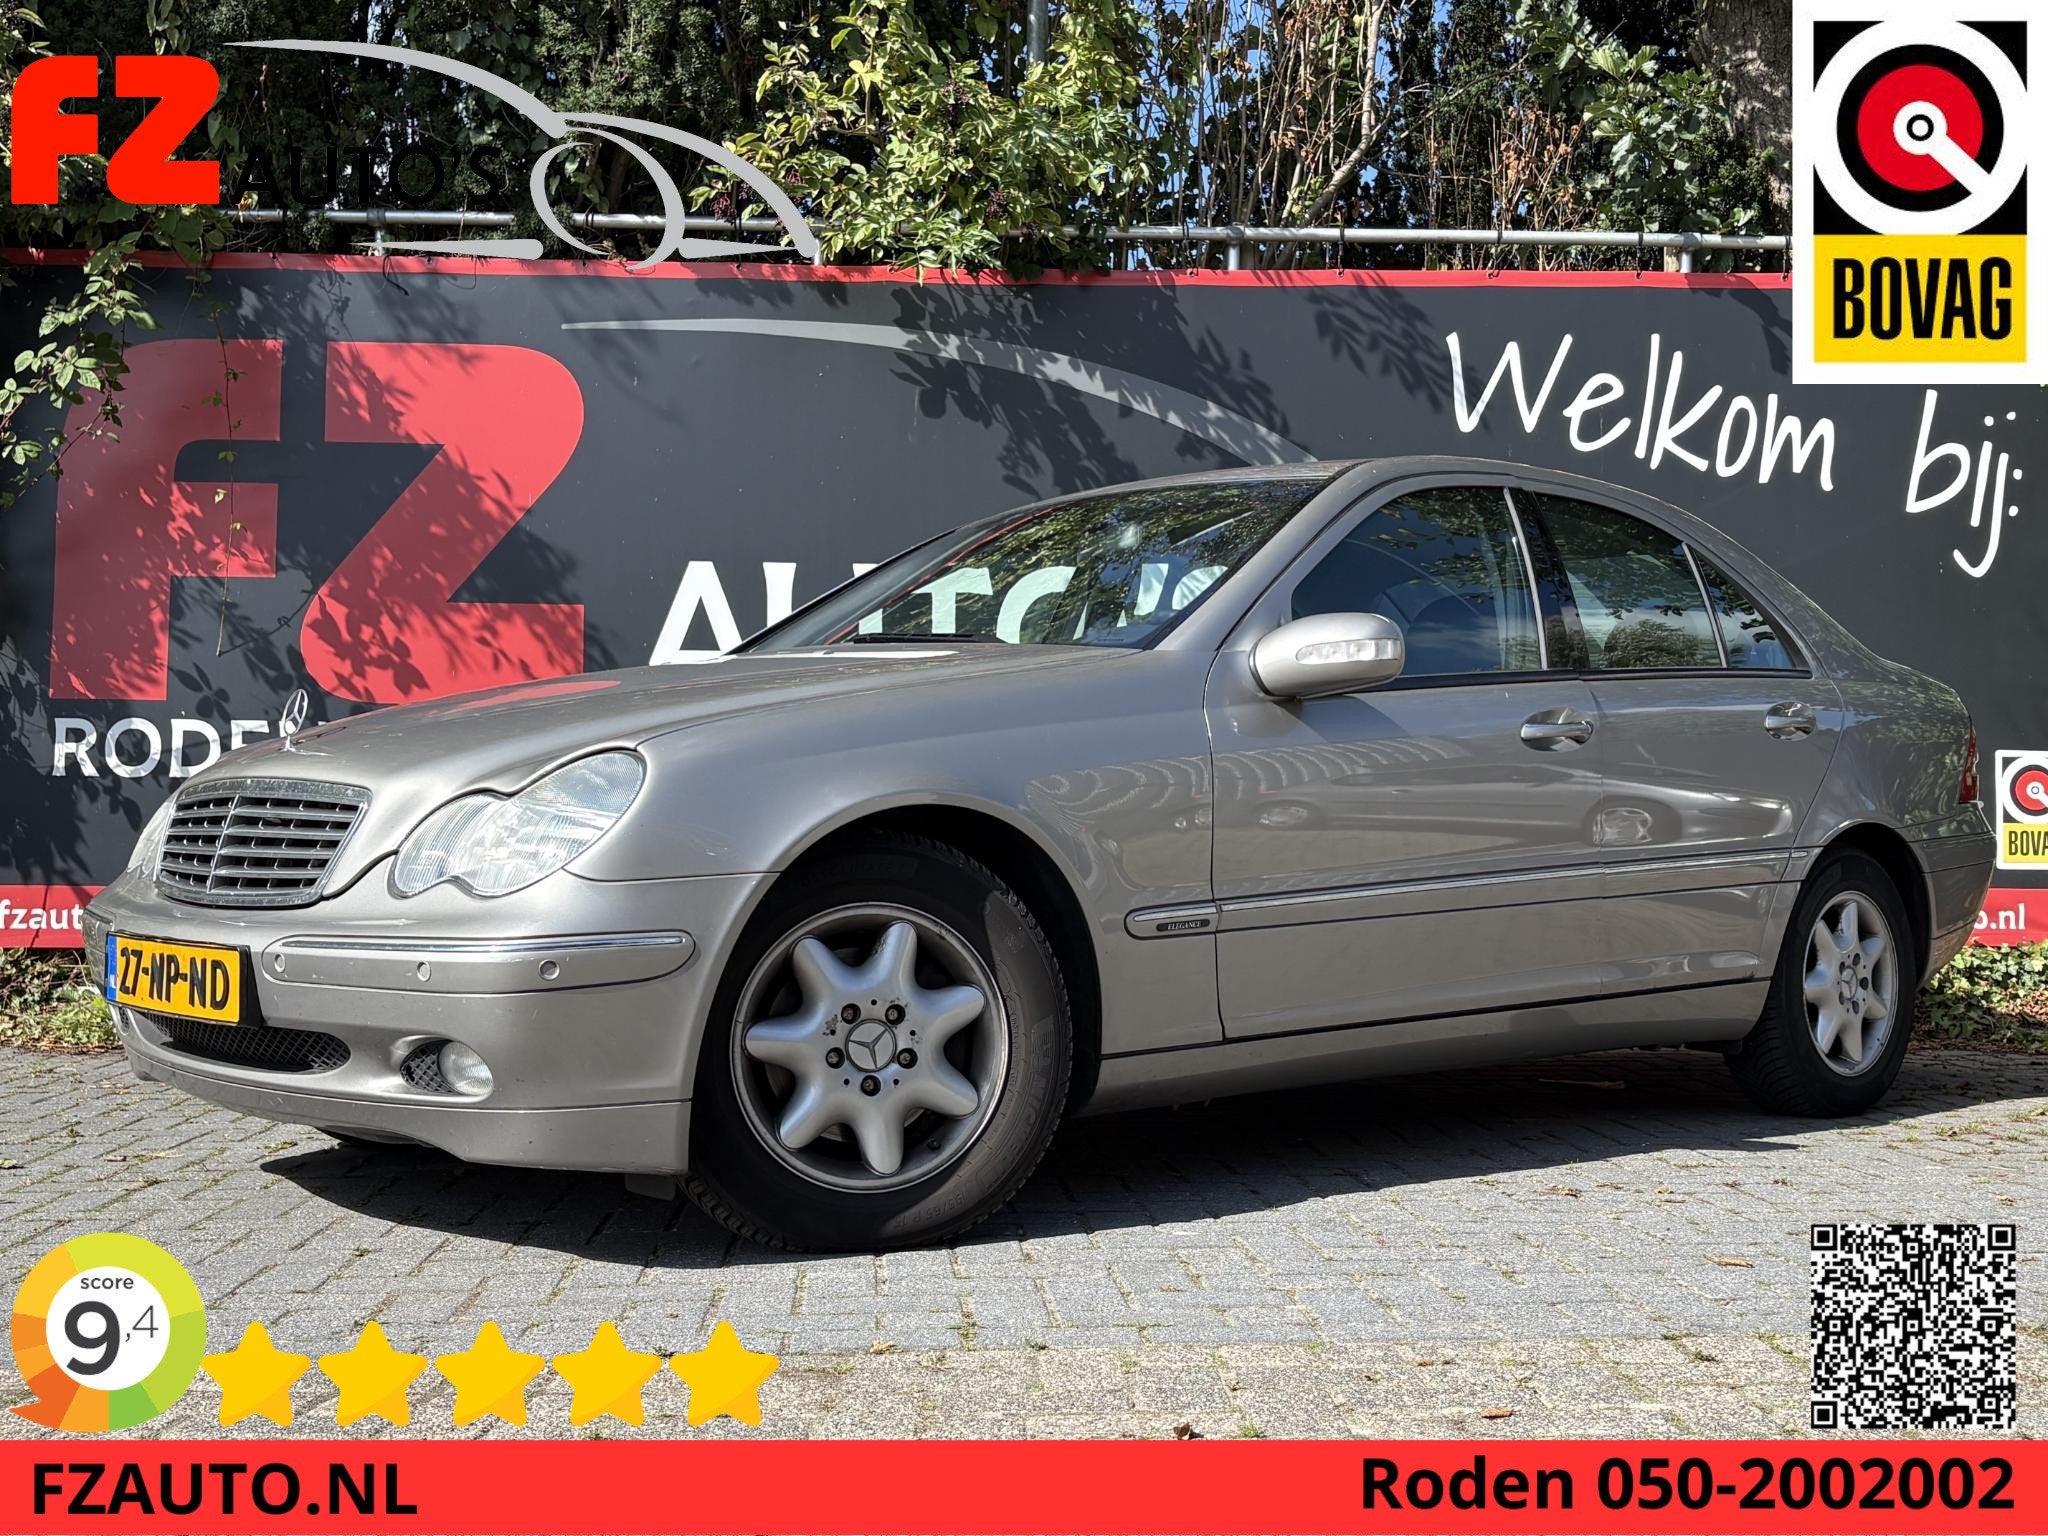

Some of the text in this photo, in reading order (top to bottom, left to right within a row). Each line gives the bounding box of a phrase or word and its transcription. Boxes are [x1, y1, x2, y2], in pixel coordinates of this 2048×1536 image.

[50, 338, 585, 705] FZ
[1446, 331, 2024, 578] Welkom bij:
[119, 946, 231, 1011] 27-NP-ND
[1167, 920, 1202, 931] ELEGANCE
